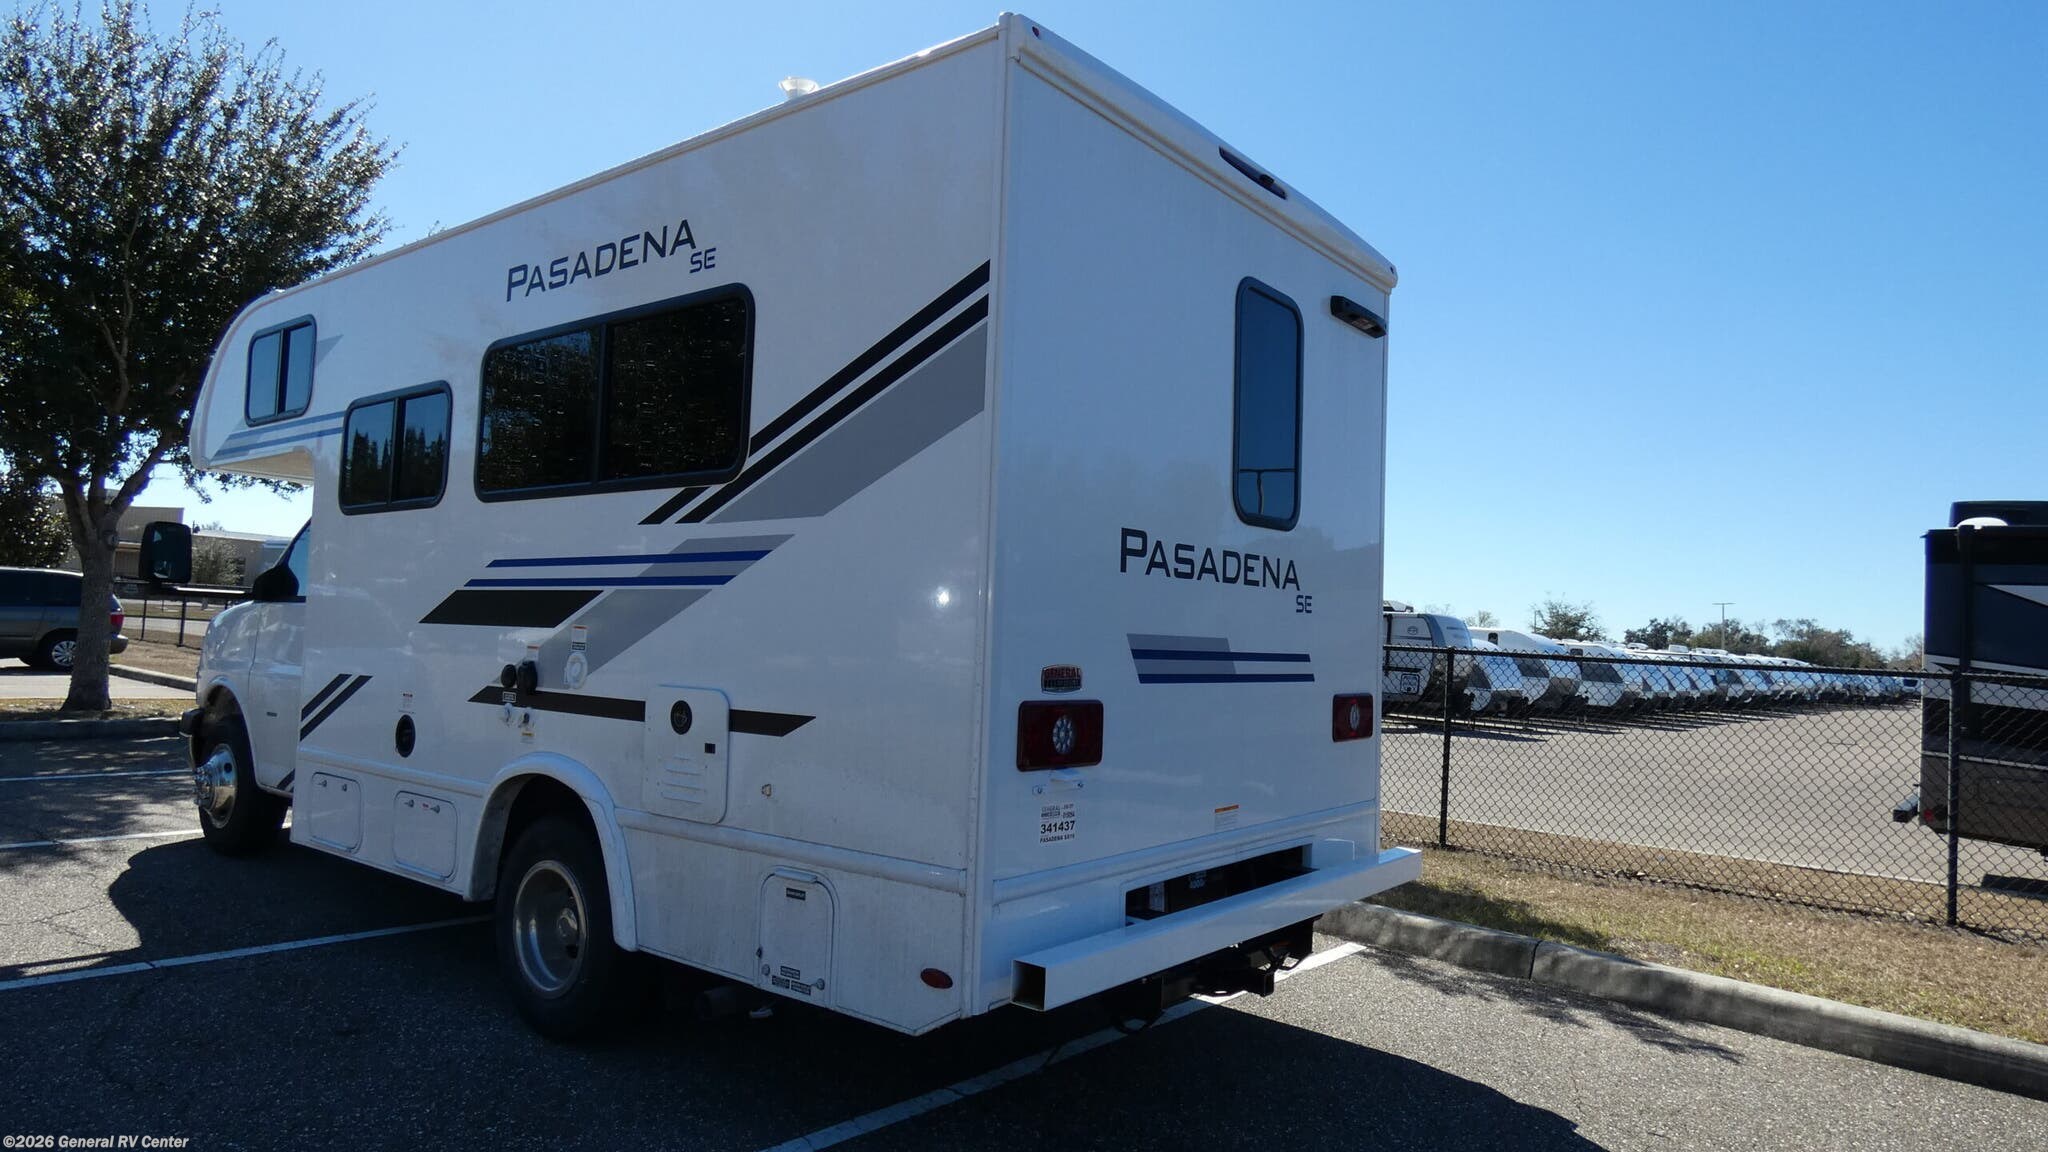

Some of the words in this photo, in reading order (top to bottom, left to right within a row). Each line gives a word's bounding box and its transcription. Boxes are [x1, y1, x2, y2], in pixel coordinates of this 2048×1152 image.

[506, 219, 696, 302] PASADENA
[689, 247, 717, 274] SE
[1120, 527, 1301, 591] PASADENA
[1296, 594, 1313, 614] SE
[1040, 820, 1076, 835] 341437
